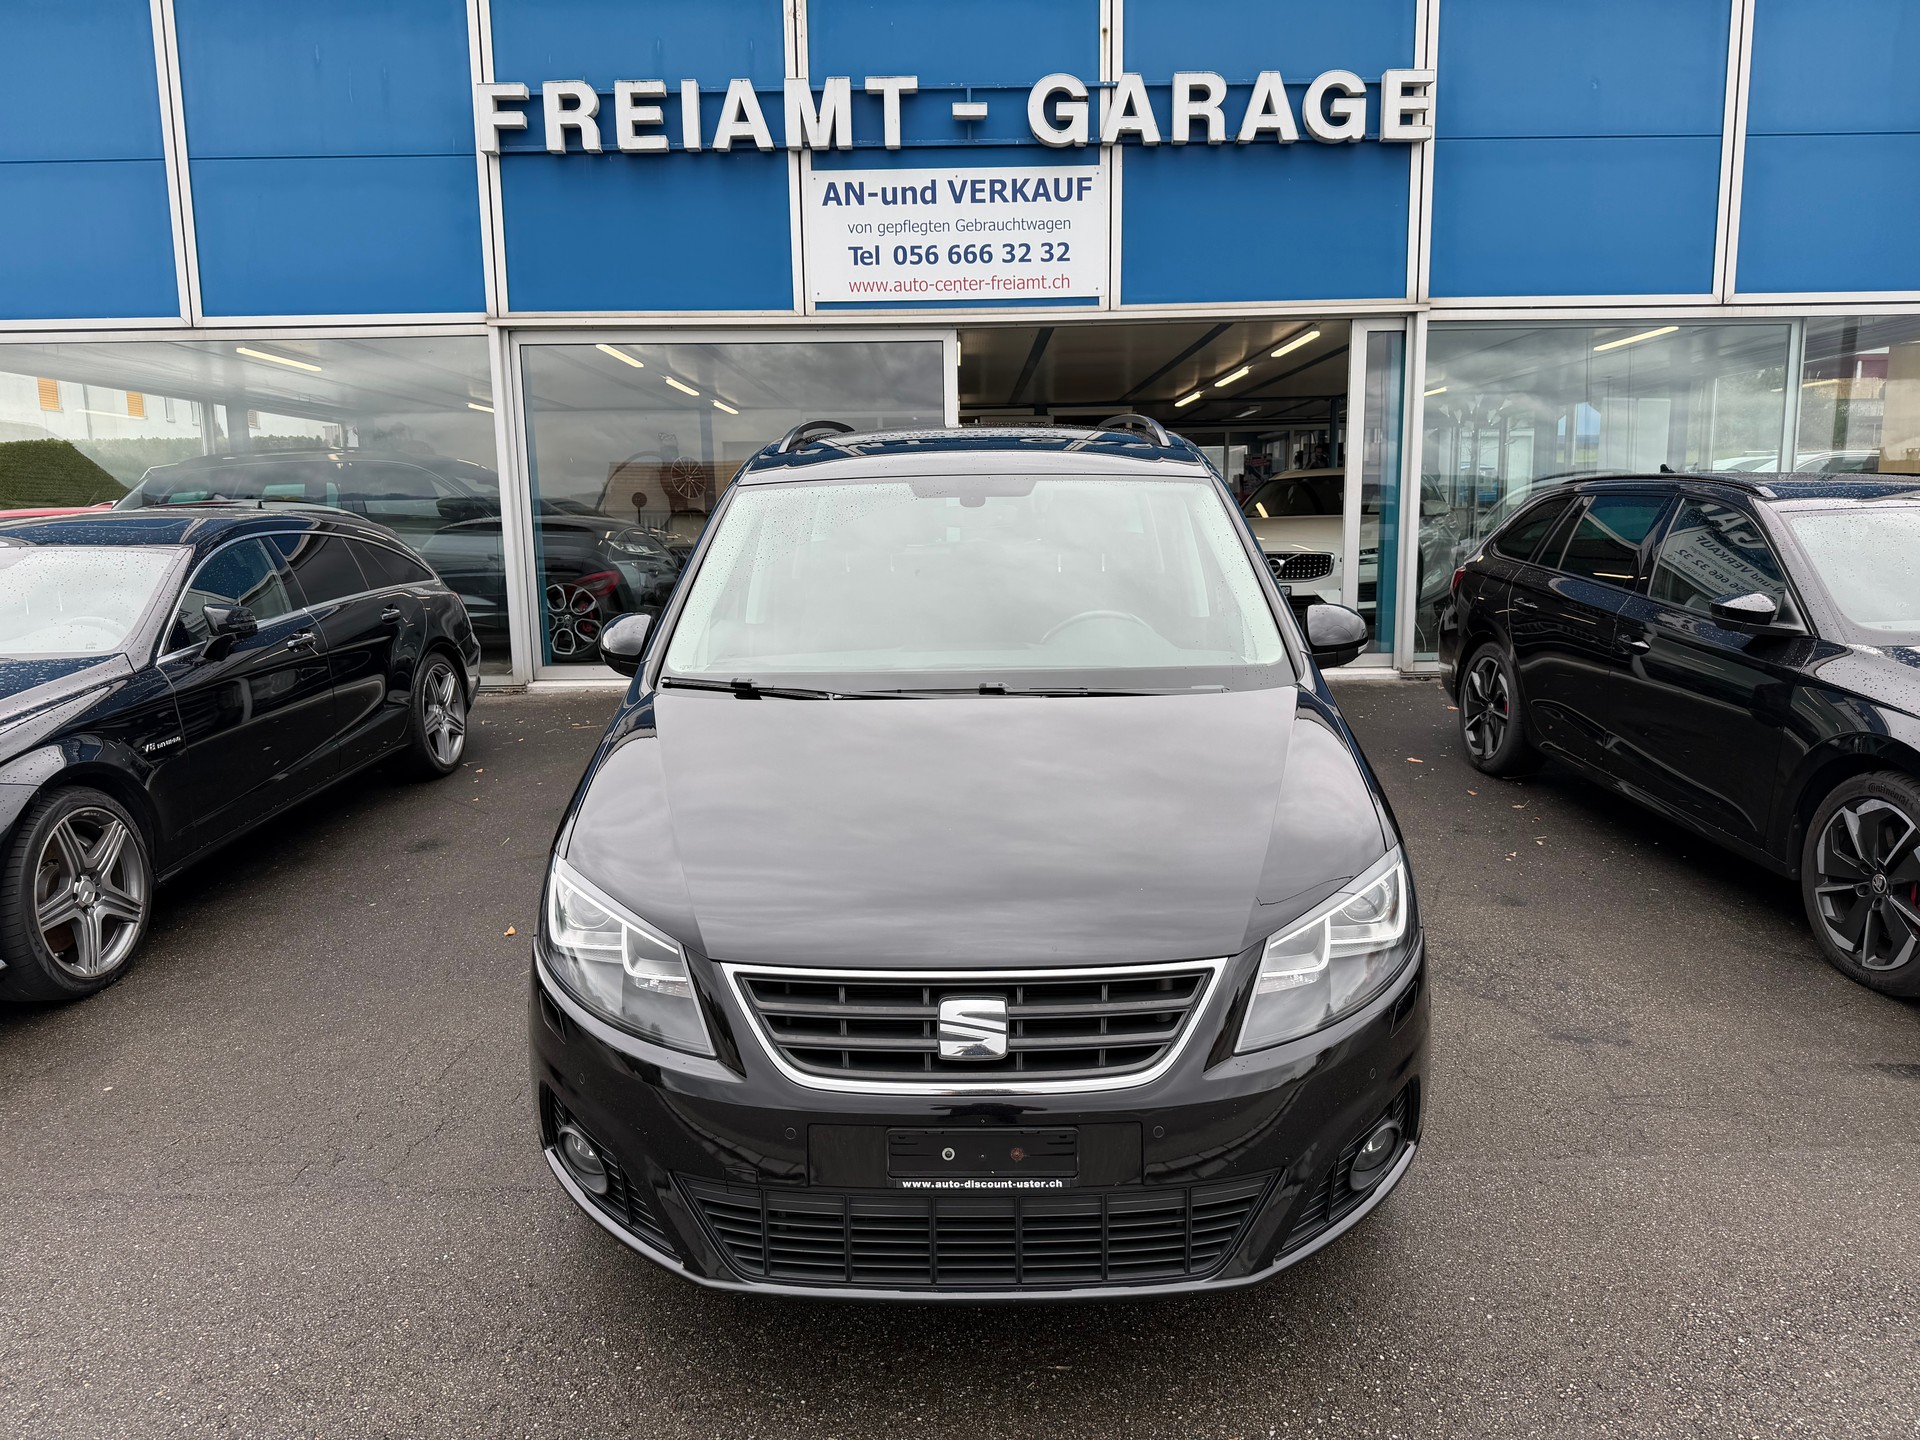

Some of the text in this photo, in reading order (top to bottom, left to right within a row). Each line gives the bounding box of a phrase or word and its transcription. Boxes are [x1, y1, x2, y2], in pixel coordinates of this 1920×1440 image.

[477, 75, 918, 156] FREIAMT
[1027, 68, 1435, 148] GARAGE
[822, 176, 1093, 207] AN-und VERKAUF
[847, 216, 1071, 236] von gepflegten Gebrauchtwagen
[848, 242, 1071, 266] Tel 056 666 32 32
[848, 273, 1071, 294] www.auto-center-freiamt.ch
[902, 1179, 1063, 1189] www.auto-discount-uster.ch
